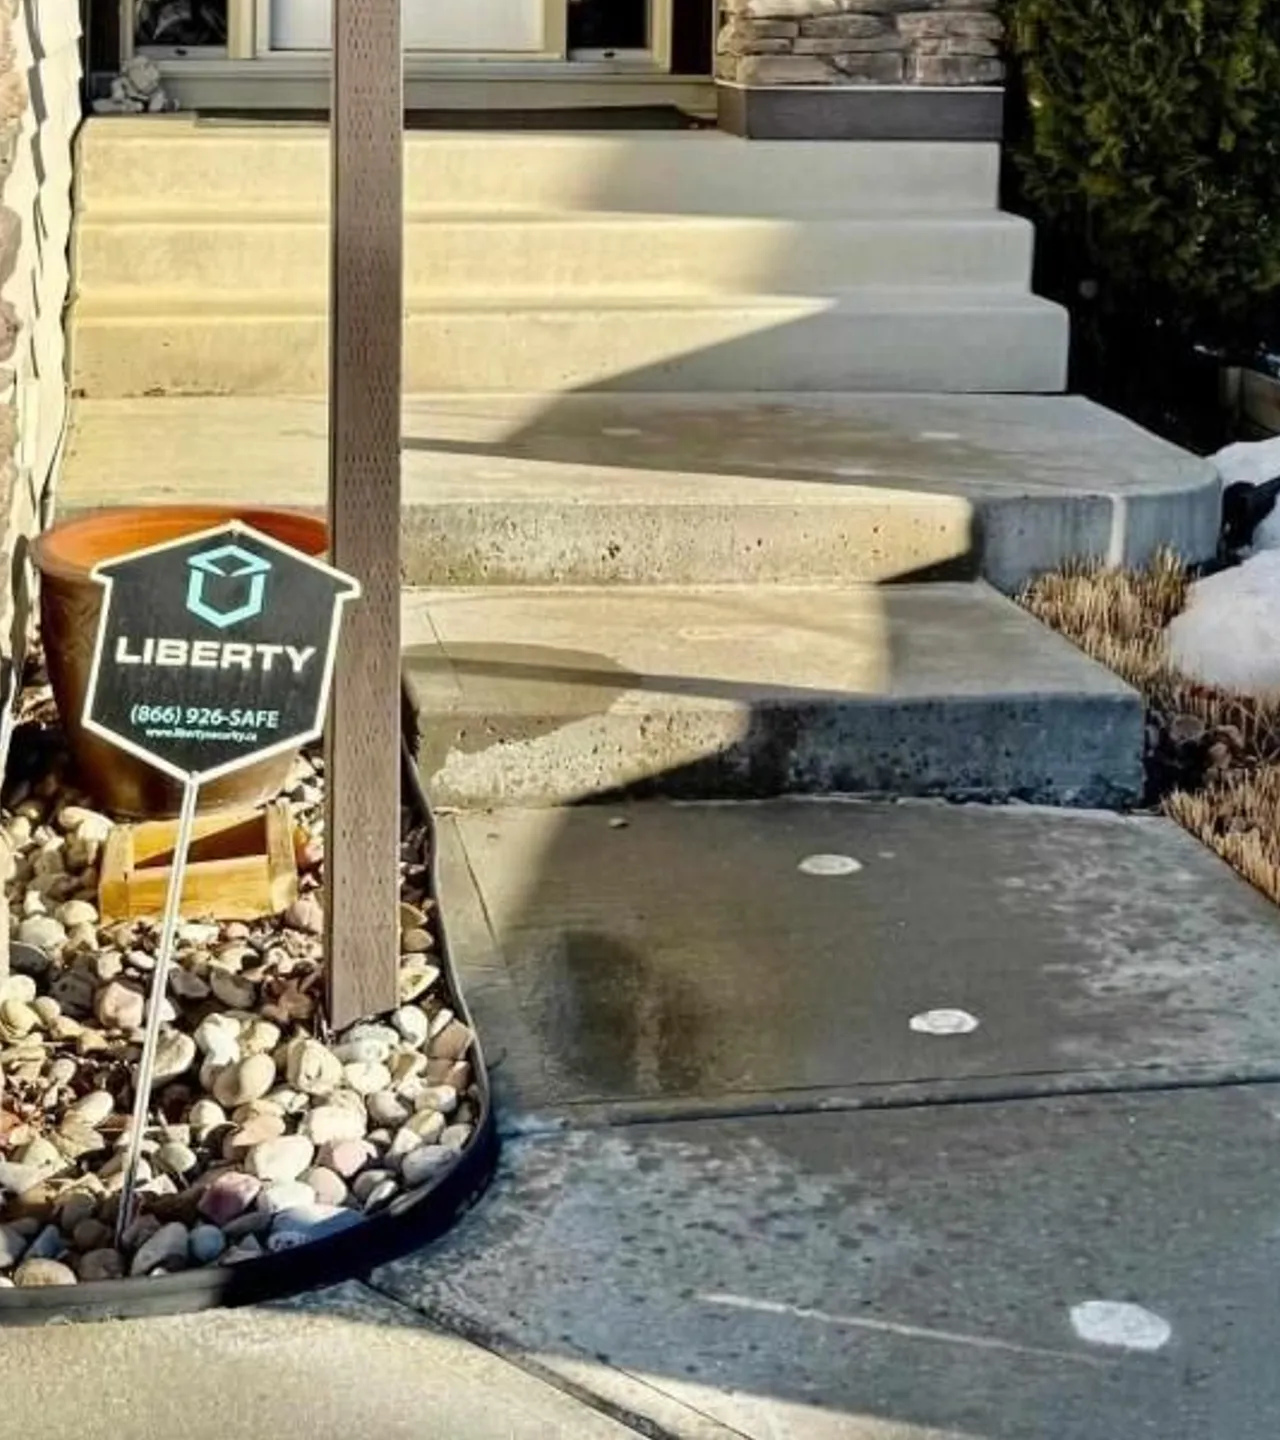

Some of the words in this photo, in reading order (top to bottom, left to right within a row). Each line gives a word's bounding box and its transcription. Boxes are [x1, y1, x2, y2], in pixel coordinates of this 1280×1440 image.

[114, 635, 317, 674] LIBERTY
[130, 703, 181, 725] (866)
[185, 707, 280, 729] 926-SAFE
